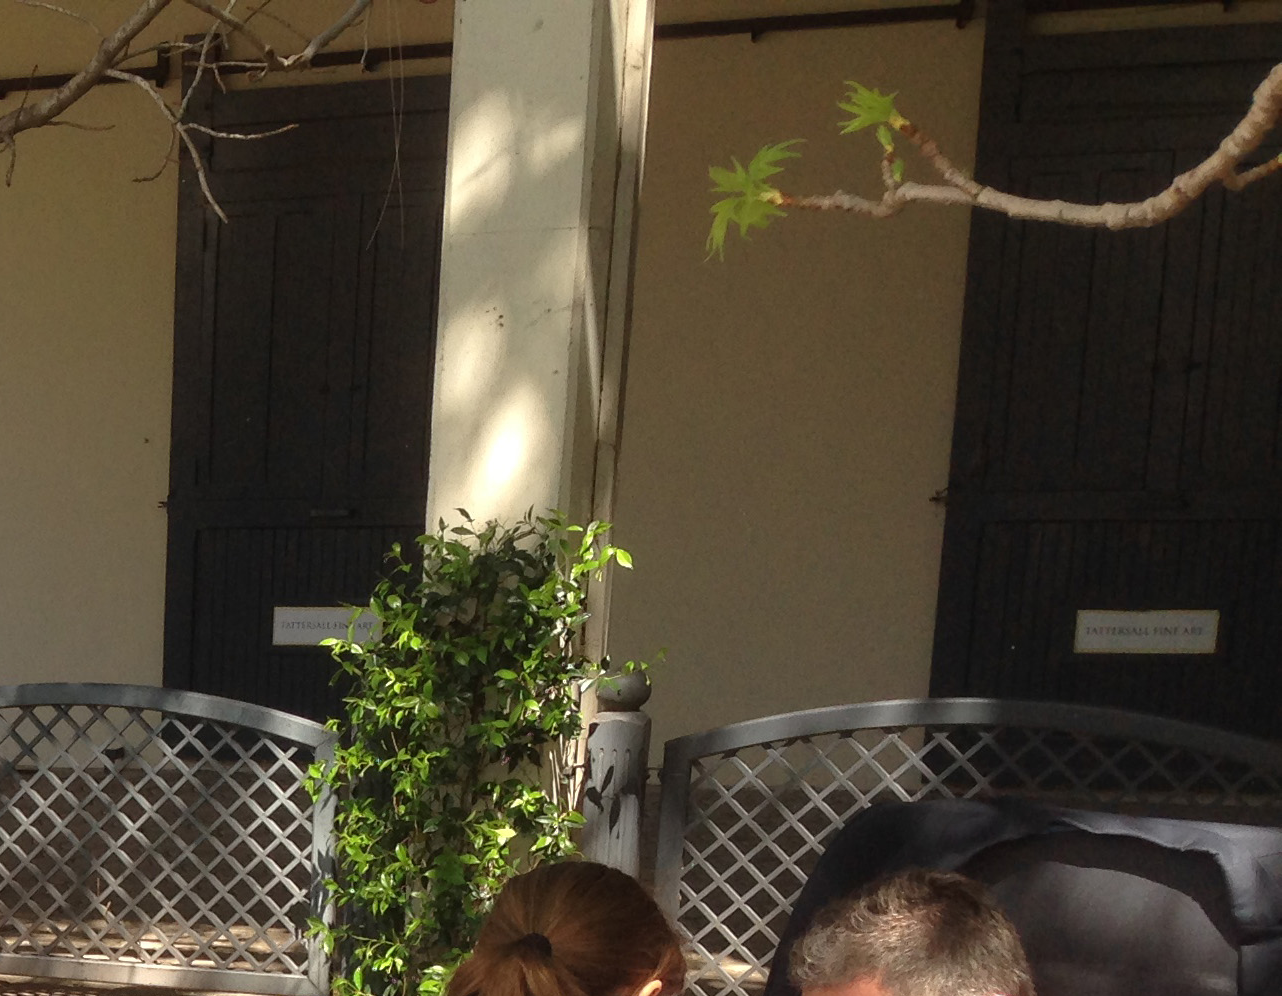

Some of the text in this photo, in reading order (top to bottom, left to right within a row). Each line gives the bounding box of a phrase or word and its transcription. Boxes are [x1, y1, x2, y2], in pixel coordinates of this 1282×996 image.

[281, 621, 374, 630] TATTERSALL FIN ART
[1085, 626, 1204, 636] TATTERSALL FINE ART
